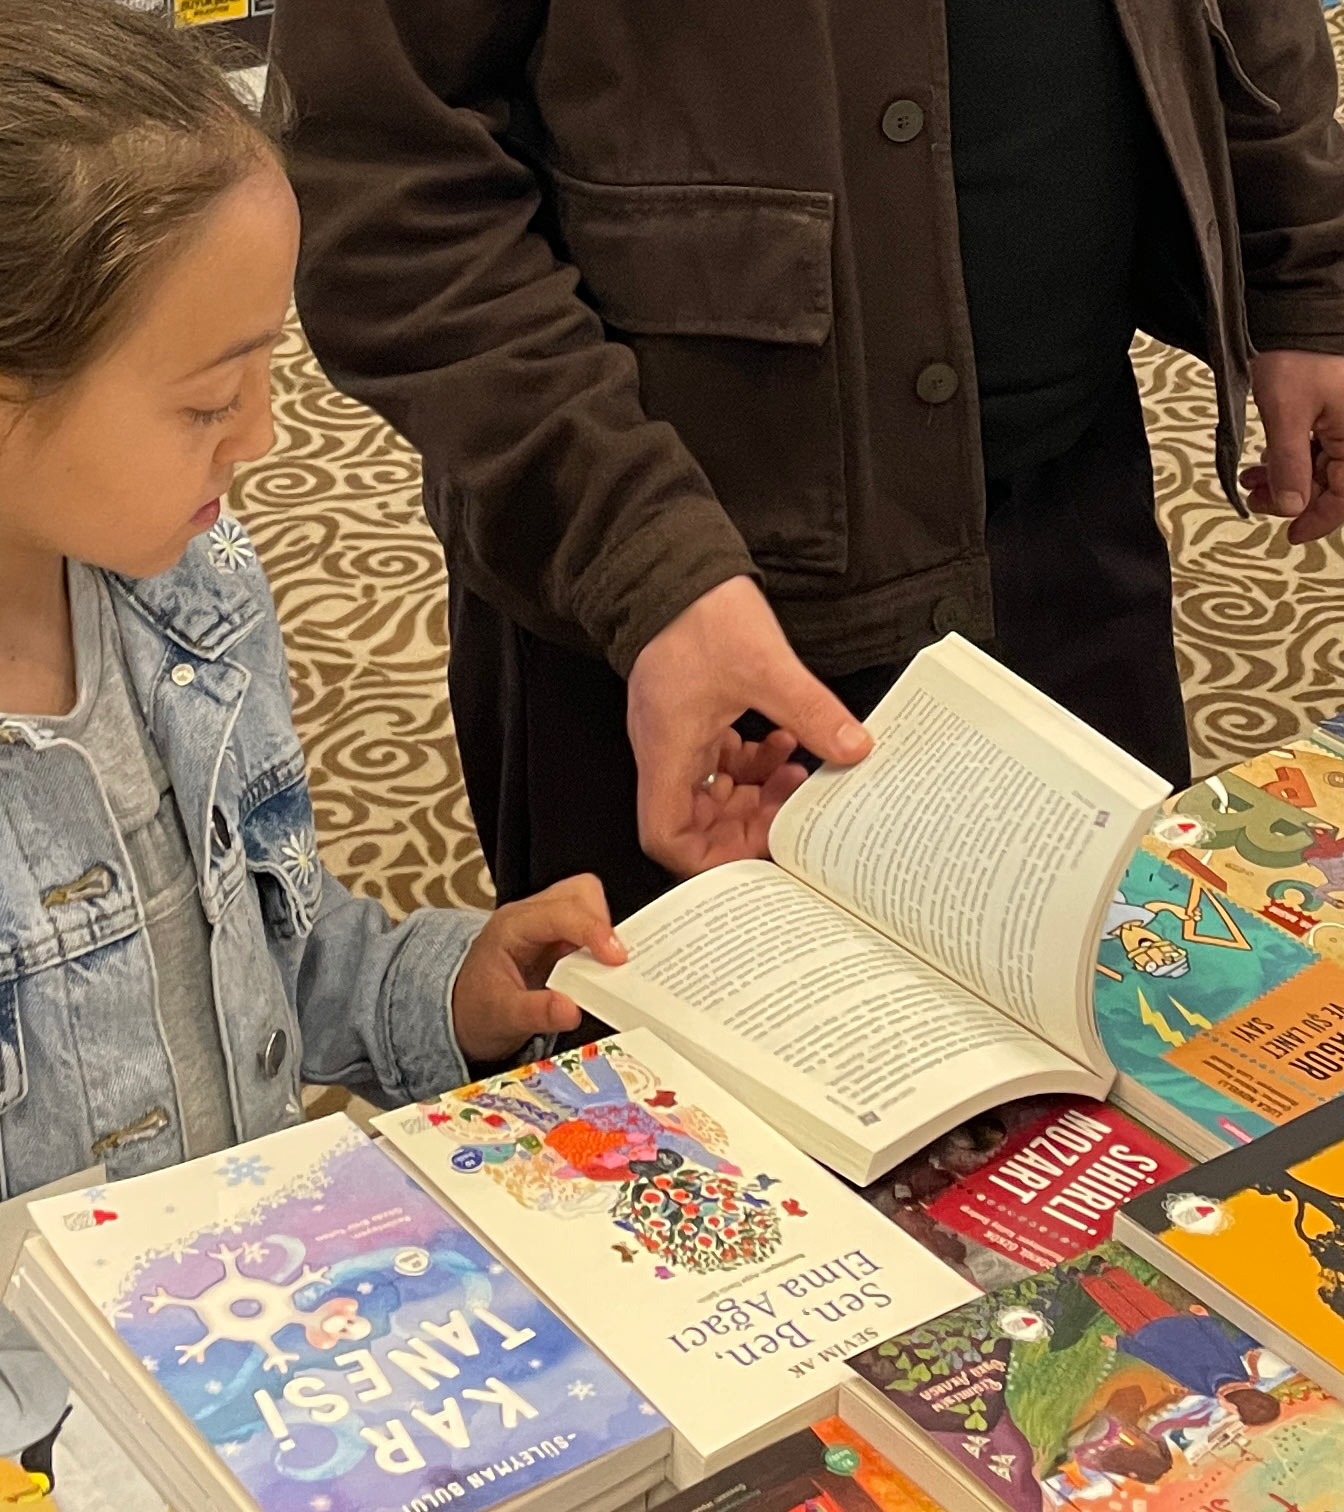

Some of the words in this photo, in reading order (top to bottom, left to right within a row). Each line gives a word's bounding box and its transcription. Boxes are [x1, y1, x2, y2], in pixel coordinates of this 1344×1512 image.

[1229, 1017, 1274, 1044] SAYI
[1259, 1026, 1308, 1060] LANET
[989, 1109, 1112, 1205] MOZART
[777, 1250, 883, 1298] Elma
[667, 1290, 776, 1353] Ağacı
[802, 1282, 892, 1323] Sen,
[715, 1320, 815, 1366] Ben,
[254, 1308, 536, 1452] TANESİ
[787, 1358, 816, 1378] AK
[359, 1377, 539, 1475] KAR
